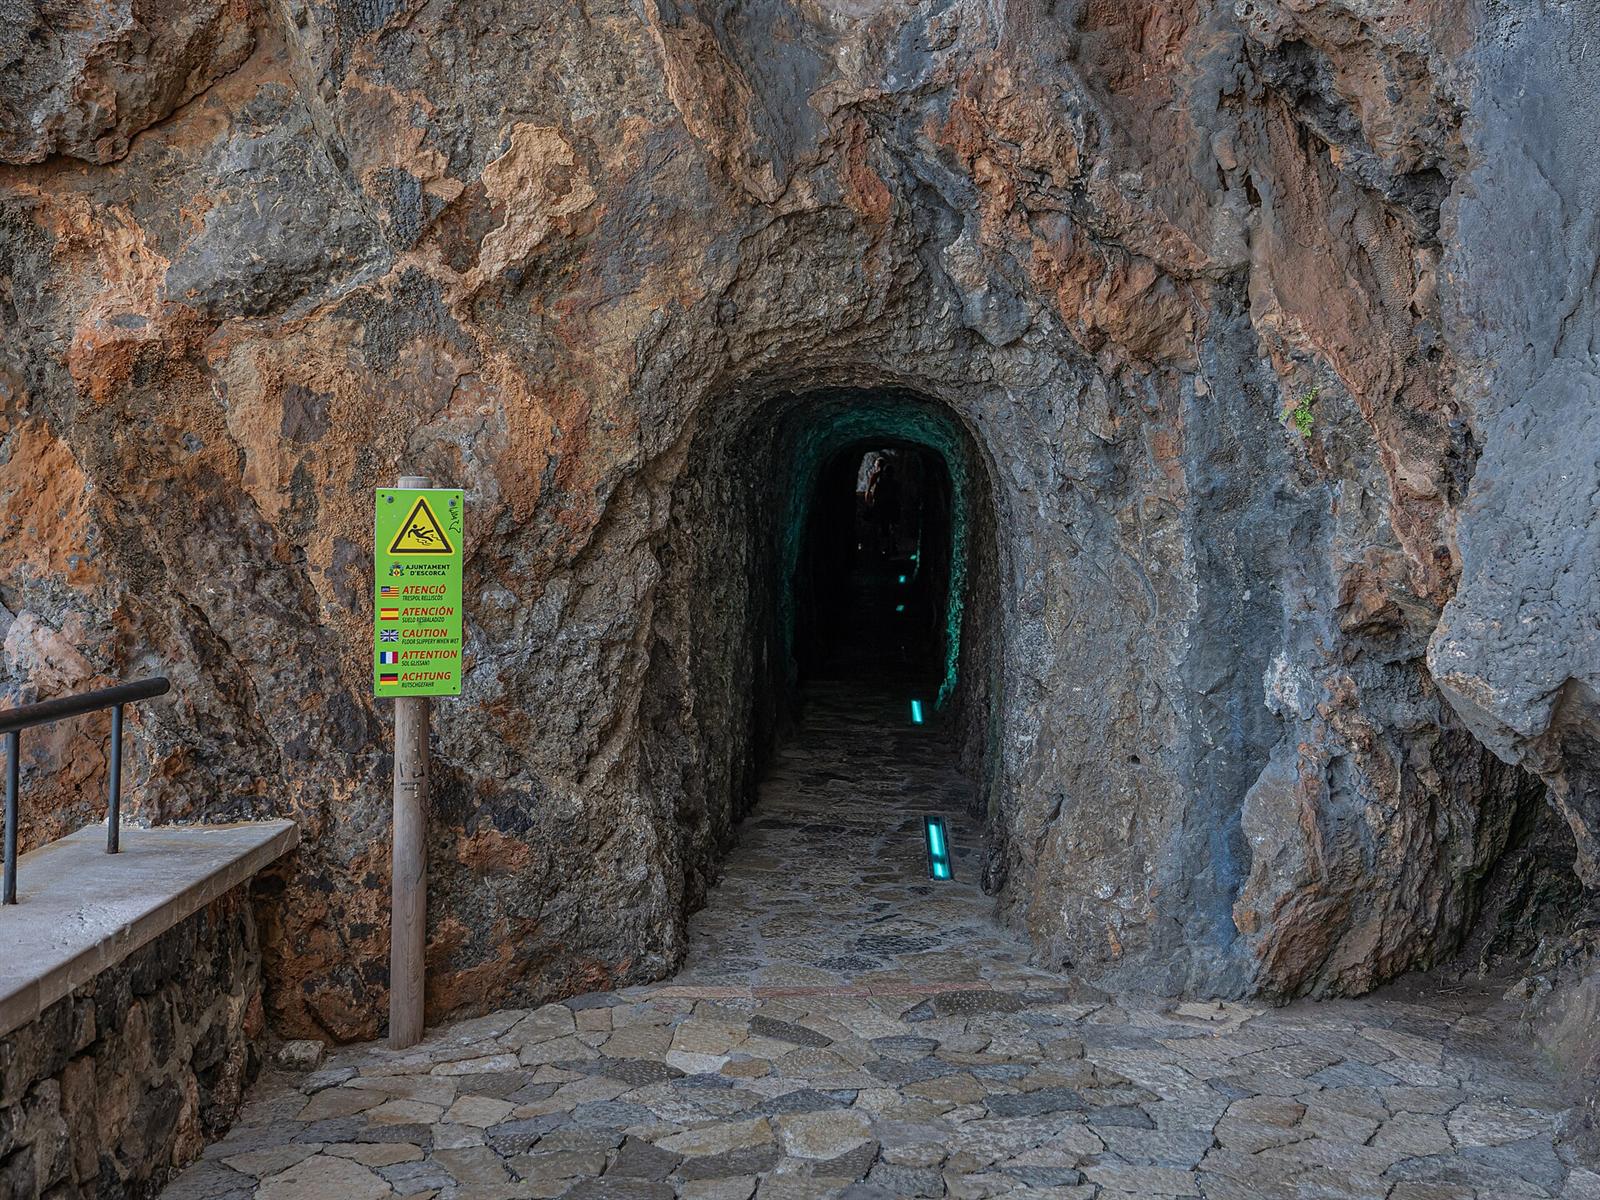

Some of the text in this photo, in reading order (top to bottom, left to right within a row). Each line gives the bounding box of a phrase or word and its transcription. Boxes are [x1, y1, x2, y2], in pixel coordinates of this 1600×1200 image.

[402, 584, 447, 595] ATENCIÓ
[402, 606, 454, 616] ATENCIÓN
[402, 629, 448, 638] CAUTION
[401, 650, 458, 659] ATTENTION
[401, 672, 451, 681] ACHTUNG
